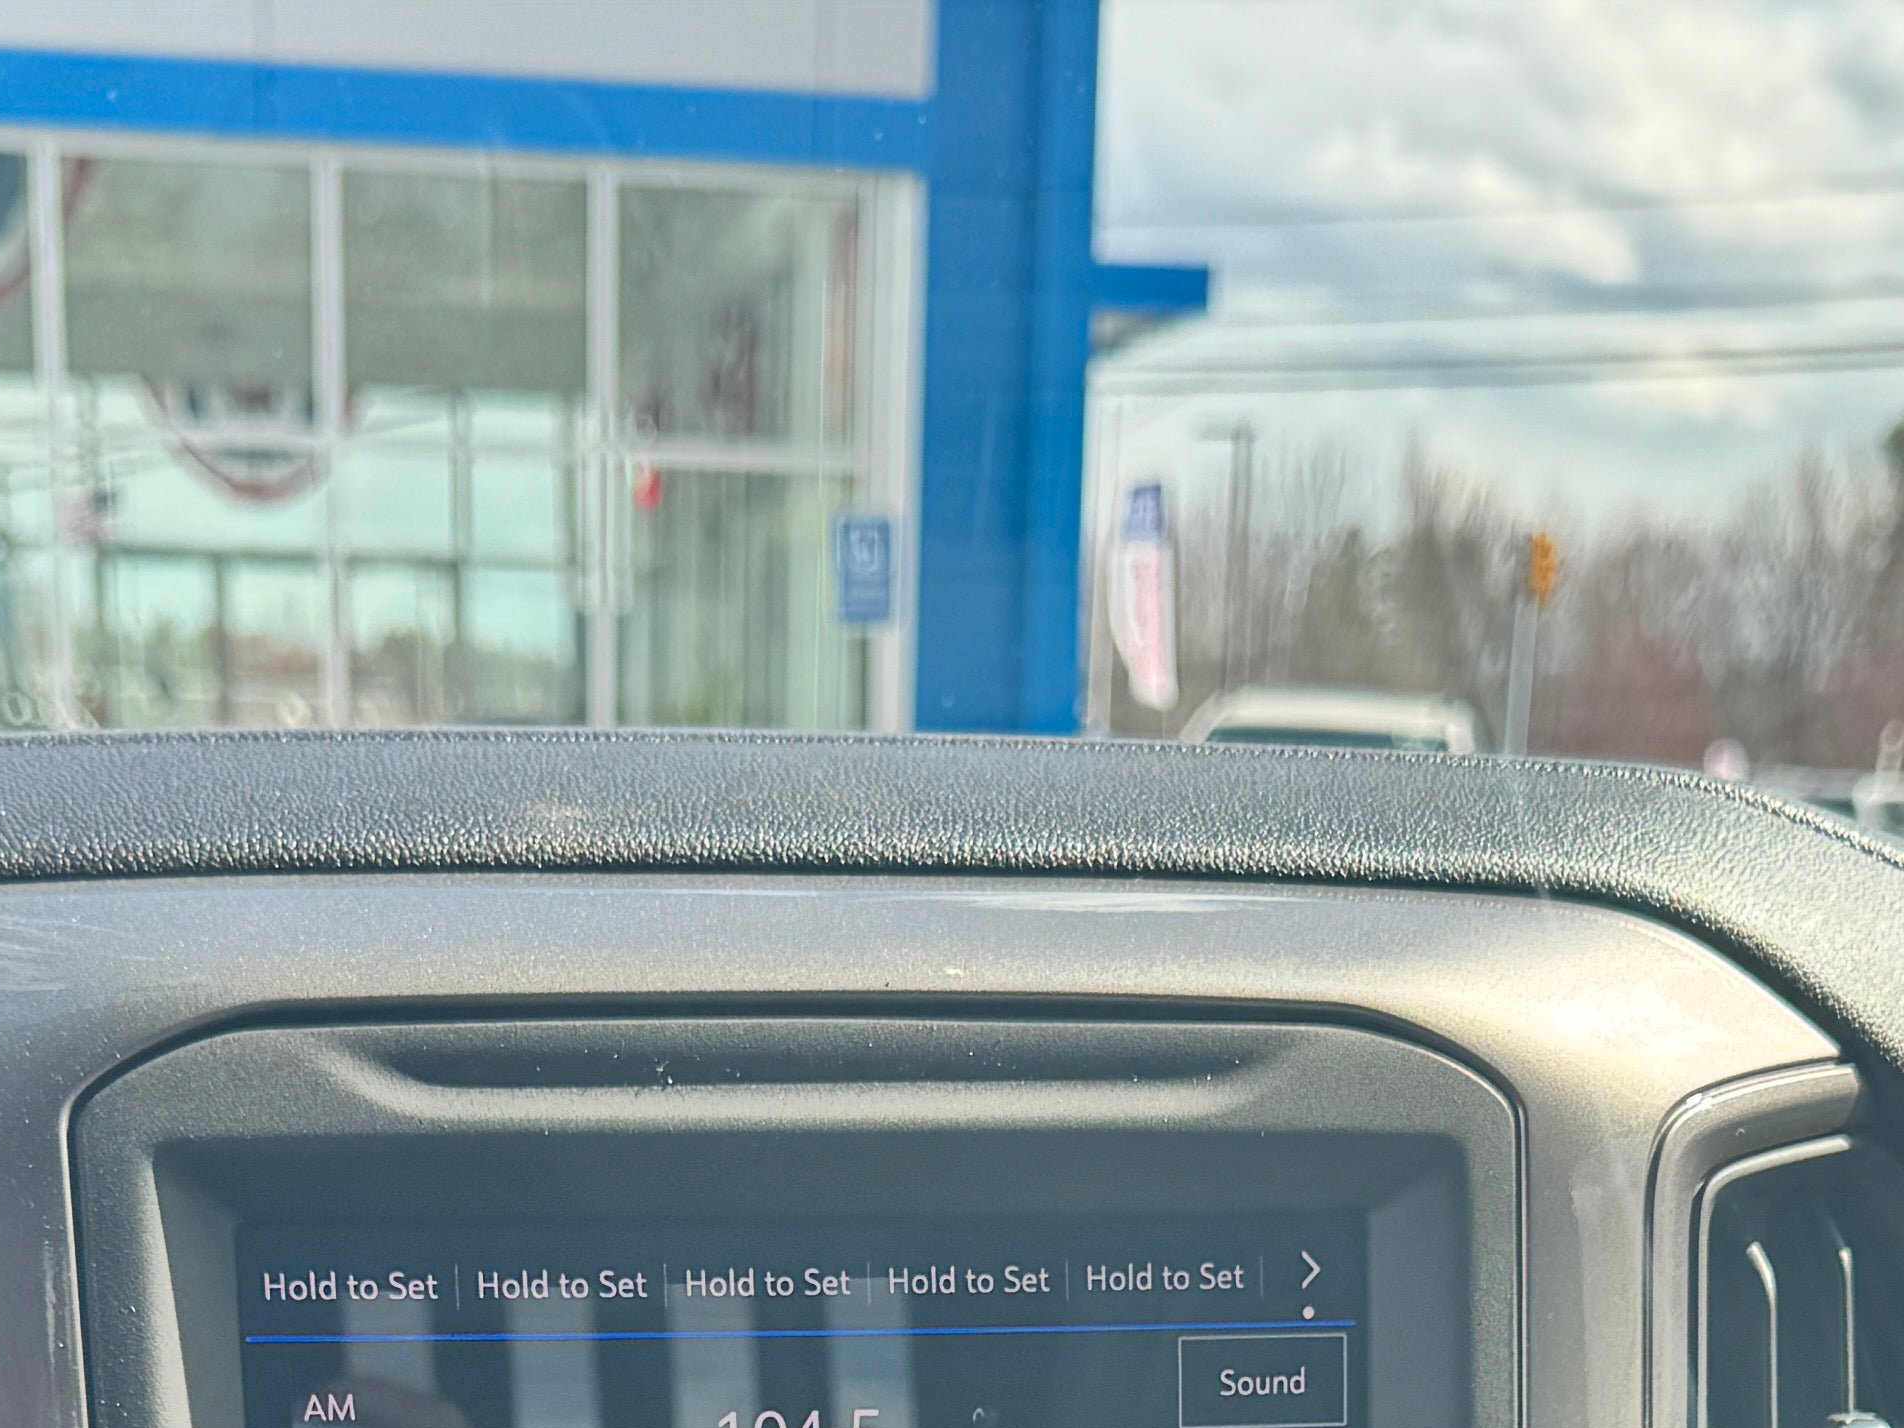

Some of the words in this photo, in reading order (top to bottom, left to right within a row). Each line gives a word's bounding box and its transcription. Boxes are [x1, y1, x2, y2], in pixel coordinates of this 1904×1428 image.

[262, 1270, 335, 1302] Hold
[346, 1274, 379, 1300] to
[388, 1271, 439, 1300] Set
[476, 1269, 547, 1300] Hold
[558, 1273, 590, 1300] to
[599, 1270, 648, 1298] Set
[686, 1267, 751, 1297] Hold
[763, 1271, 794, 1297] to
[804, 1267, 852, 1296] Set
[887, 1265, 954, 1295] Hold
[964, 1268, 995, 1294] to
[1003, 1265, 1050, 1293] Set
[1085, 1262, 1152, 1292] Hold
[1161, 1265, 1190, 1291] to
[1199, 1262, 1245, 1290] Set
[1219, 1366, 1306, 1396] Sound
[303, 1393, 356, 1422] AM
